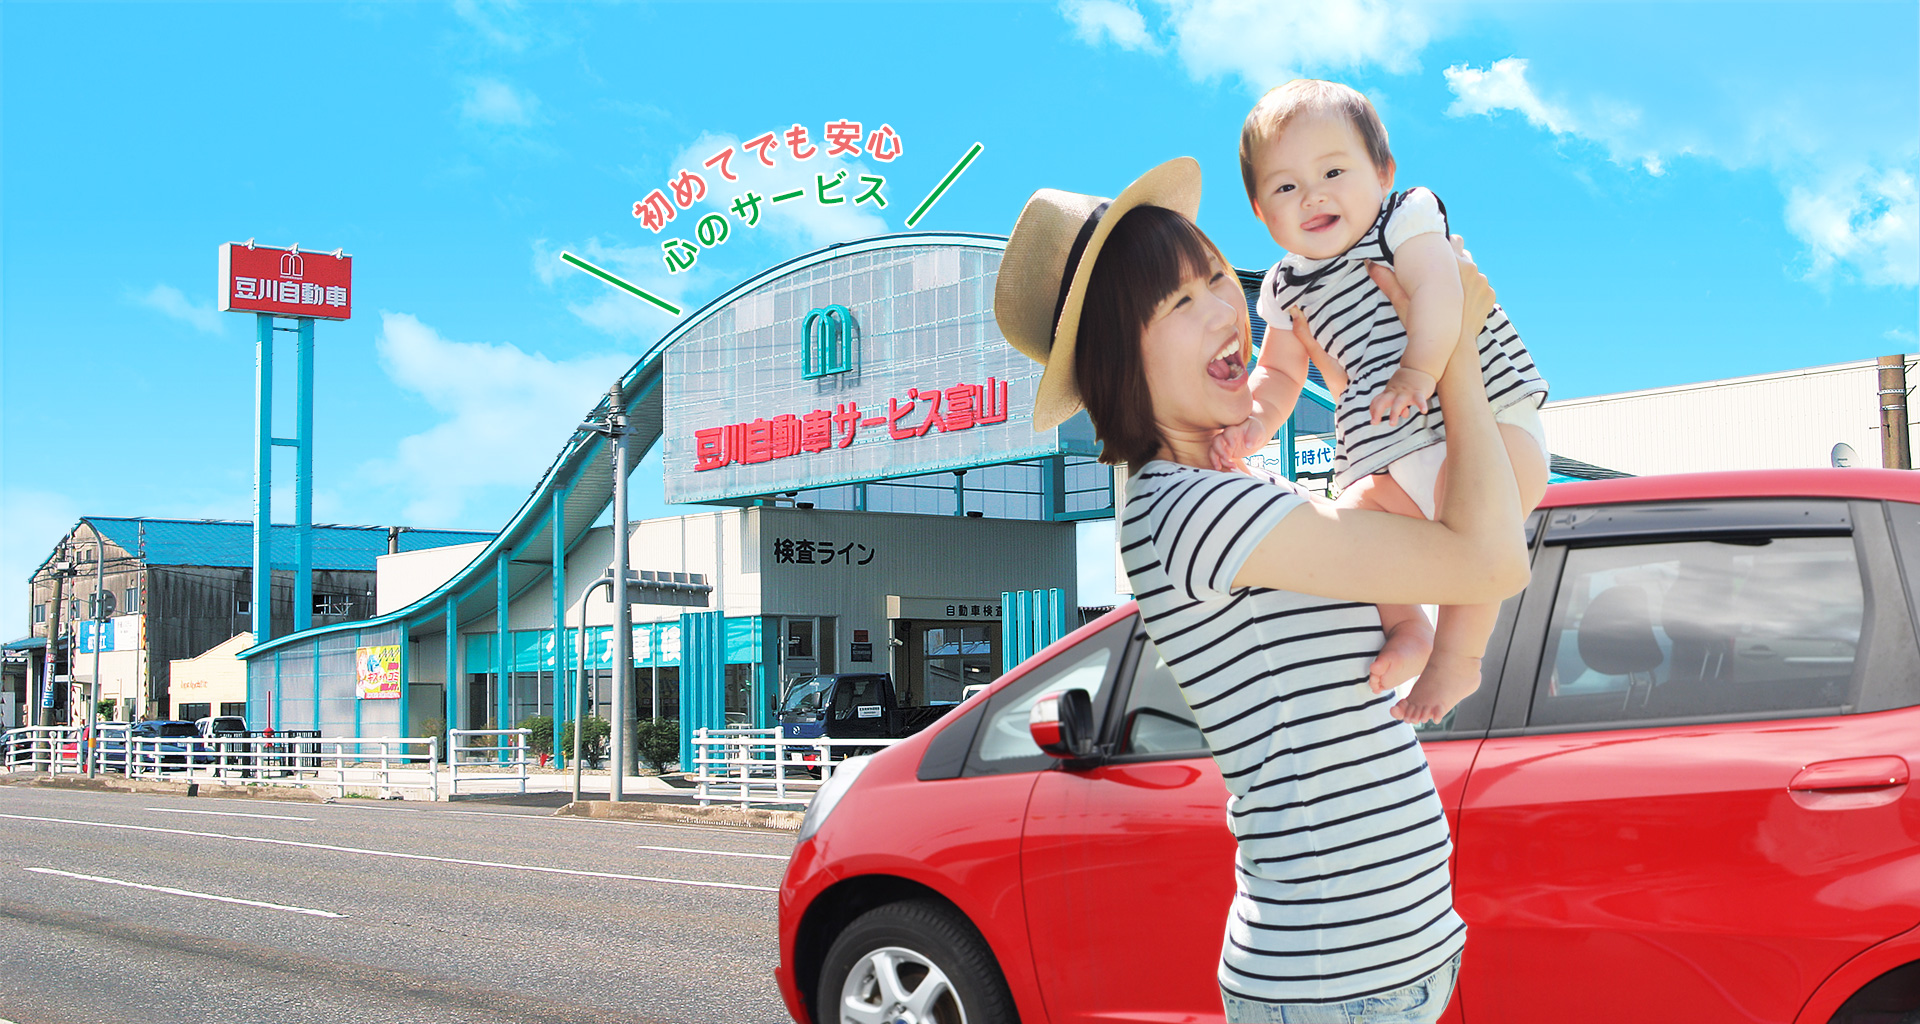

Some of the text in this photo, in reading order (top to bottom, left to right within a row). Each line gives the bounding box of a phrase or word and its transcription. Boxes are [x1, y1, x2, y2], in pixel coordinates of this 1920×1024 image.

[235, 276, 347, 308] 豆川自動車
[694, 377, 1008, 471] 豆川自動車サービス富山
[773, 538, 875, 566] 検査ライン
